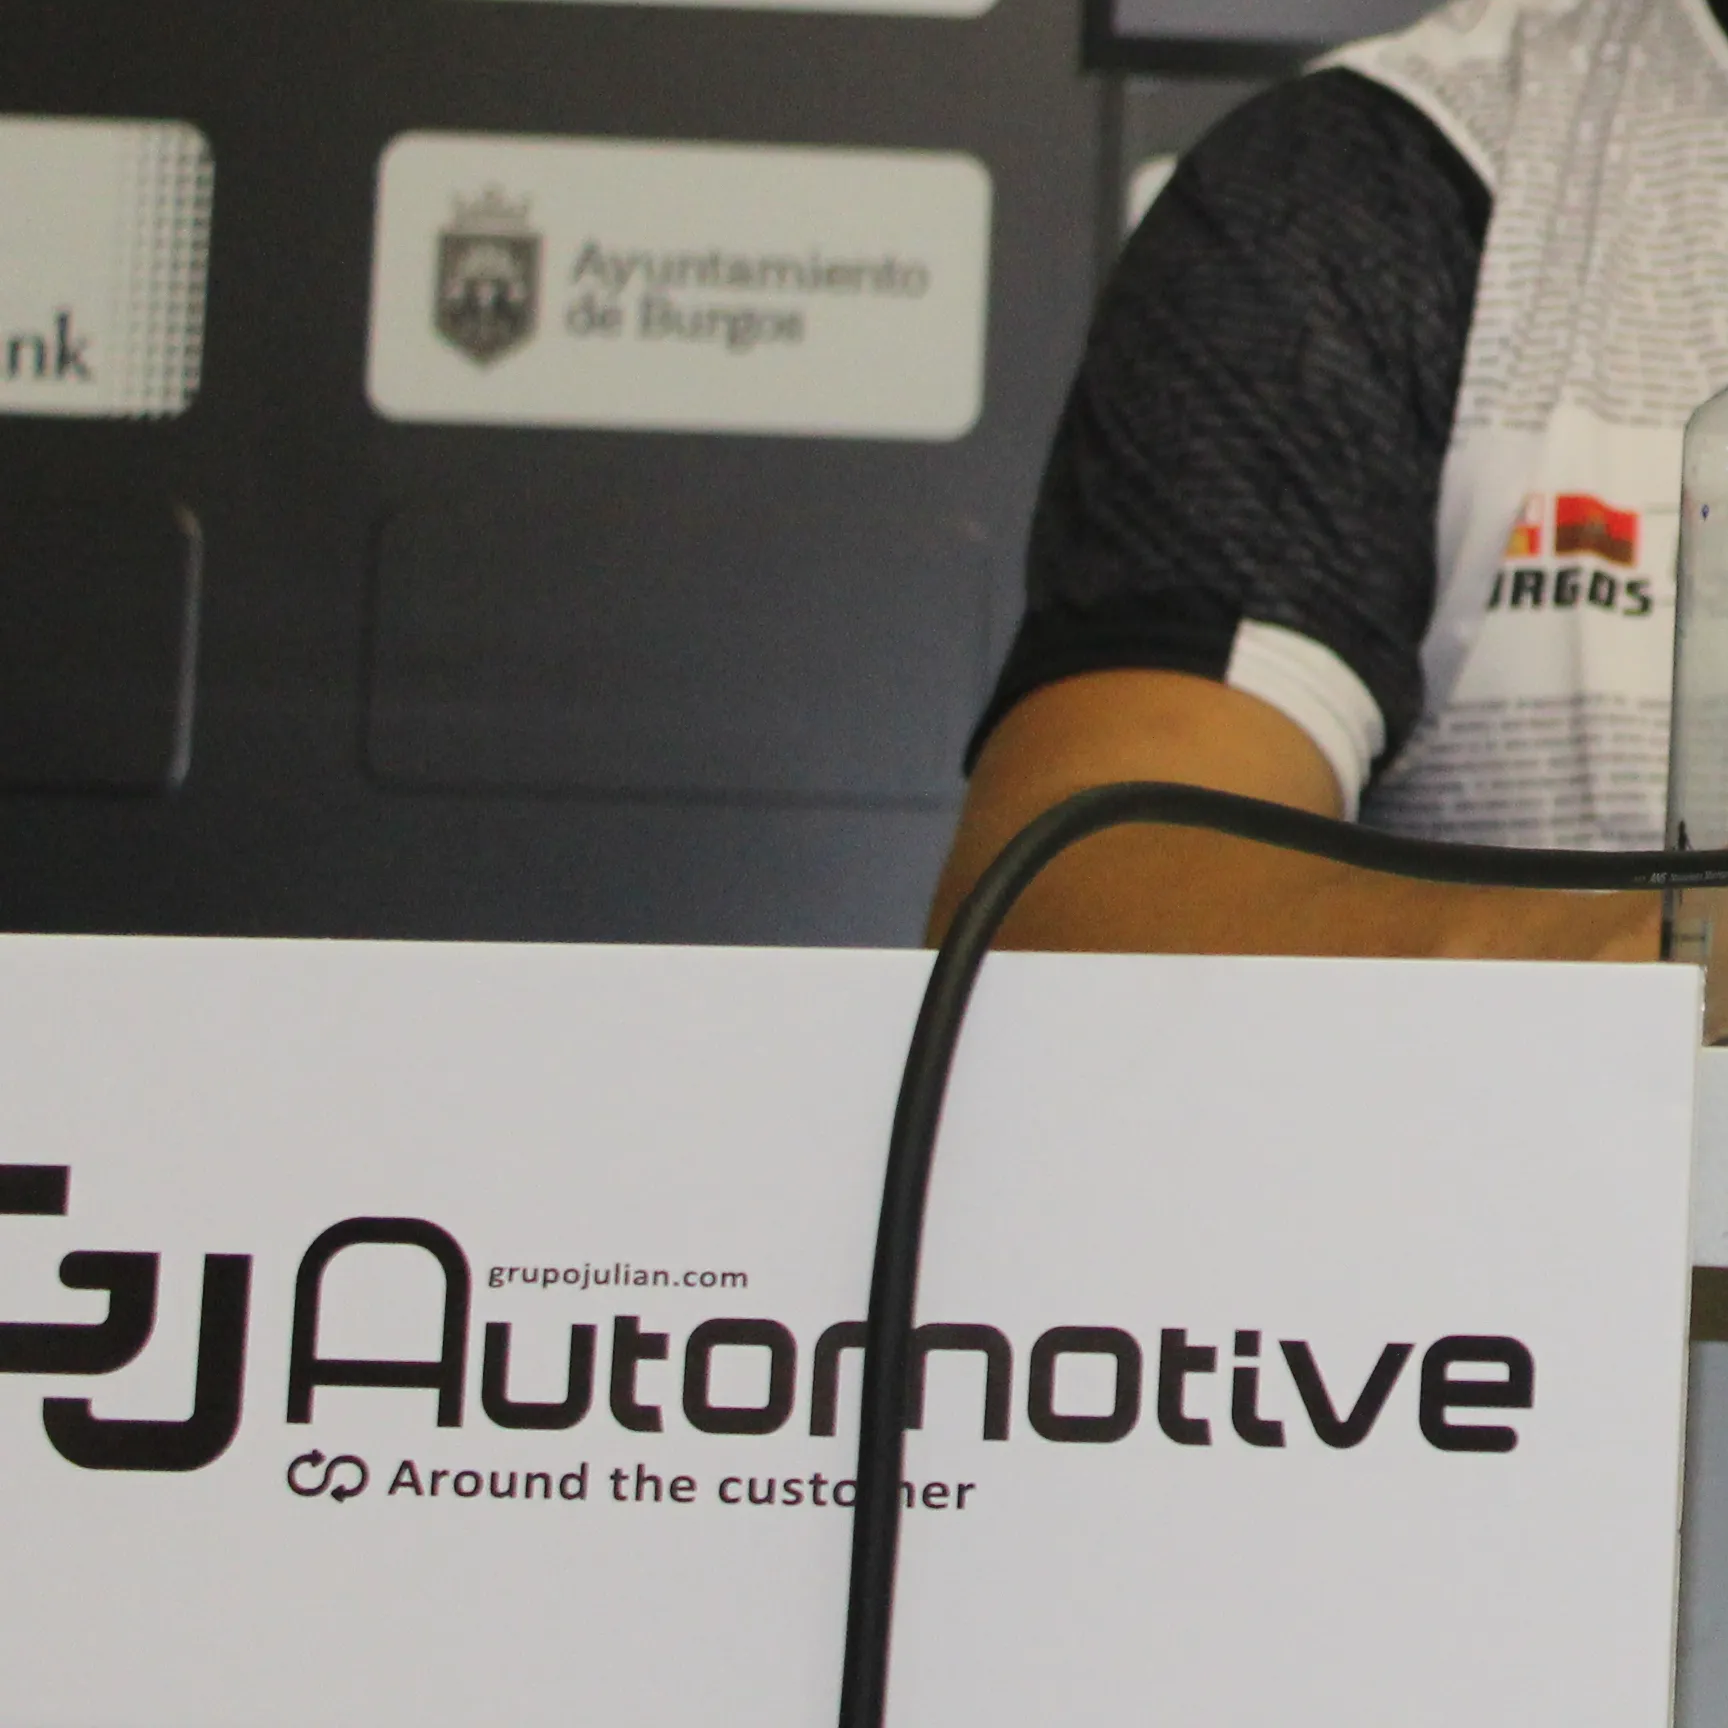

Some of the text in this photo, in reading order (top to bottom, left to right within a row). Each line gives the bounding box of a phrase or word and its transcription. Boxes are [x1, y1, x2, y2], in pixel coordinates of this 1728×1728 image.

[568, 242, 932, 304] Ayuntamiento
[565, 292, 806, 356] de Burgos
[487, 1262, 749, 1294] grupojulian.com
[287, 1216, 1536, 1453] Automotive
[388, 1458, 587, 1502] Around
[608, 1460, 698, 1504] the
